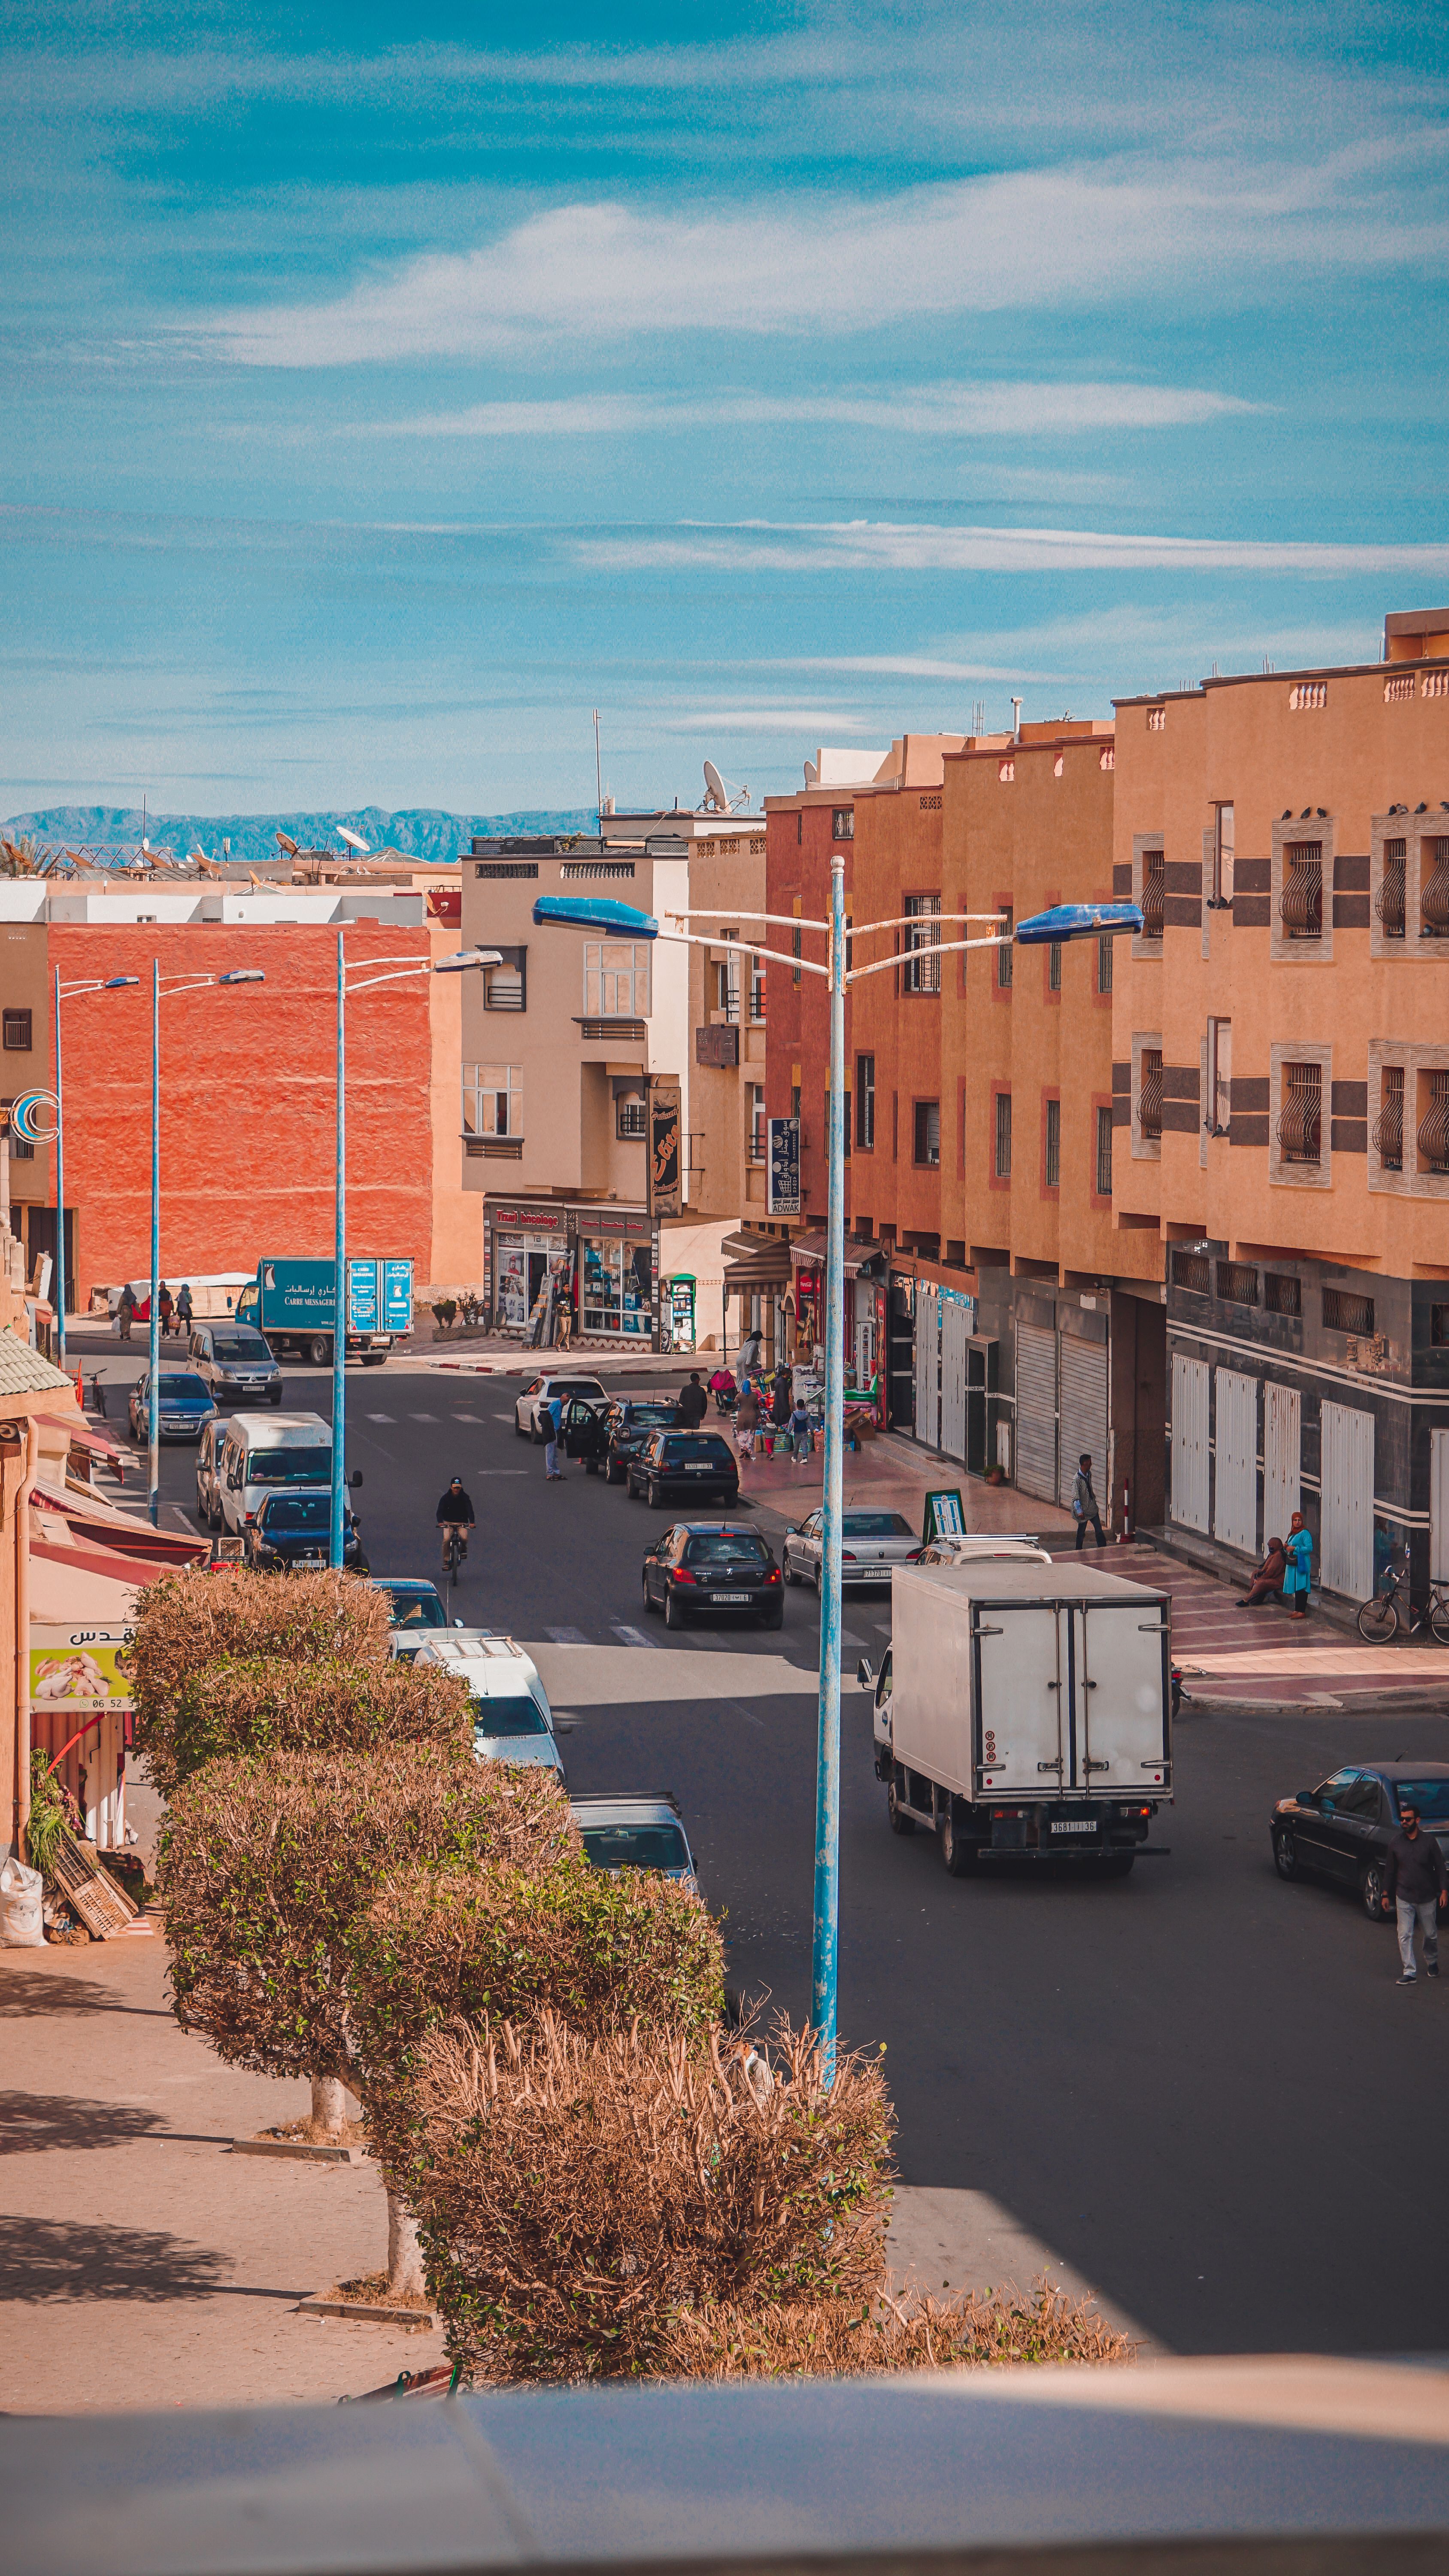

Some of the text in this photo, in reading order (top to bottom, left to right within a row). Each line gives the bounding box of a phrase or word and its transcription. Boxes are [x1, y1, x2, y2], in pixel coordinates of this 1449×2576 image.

[651, 1124, 680, 1181] Elite
[652, 1179, 679, 1193] Boulangerie
[773, 1204, 799, 1212] ADWAK
[520, 1211, 558, 1229] bricolage
[93, 1699, 104, 1708] 06
[110, 1699, 122, 1707] 52
[1054, 1823, 1070, 1832] 3681
[1085, 1822, 1094, 1831] 36
